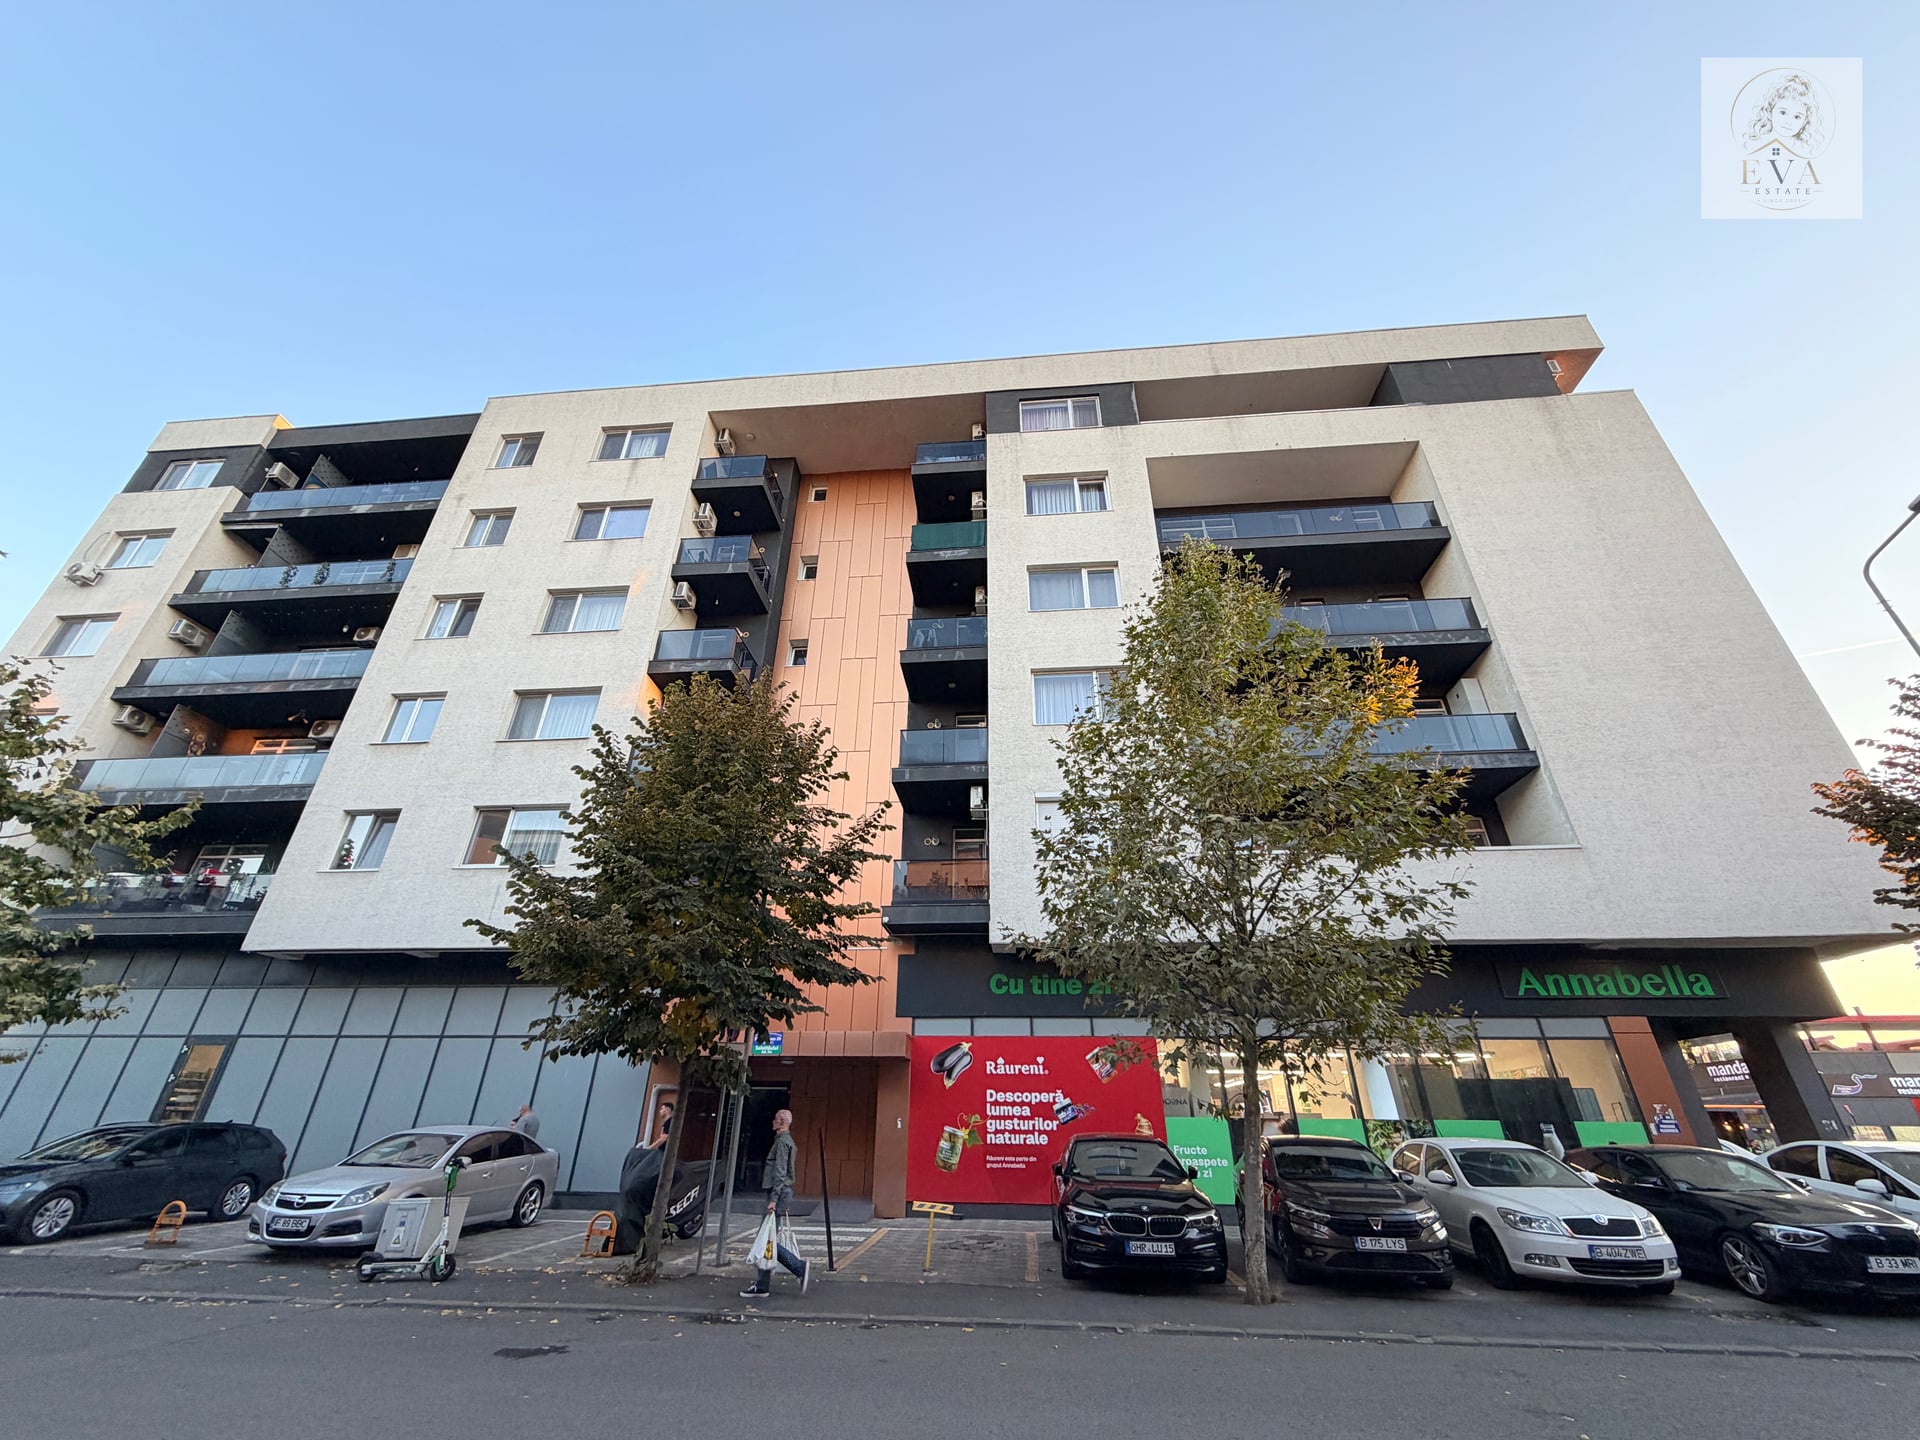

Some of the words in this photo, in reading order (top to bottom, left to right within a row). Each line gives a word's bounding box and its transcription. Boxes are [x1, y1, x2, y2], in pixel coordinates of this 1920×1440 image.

[990, 973, 1024, 995] Cu
[1030, 973, 1082, 995] tine
[1518, 964, 1715, 996] Annabella
[985, 1089, 1064, 1104] Descoperă
[985, 1103, 1031, 1116] lumea
[986, 1117, 1059, 1132] gusturilor
[986, 1131, 1049, 1145] naturale
[1173, 1145, 1208, 1155] Fructe
[1203, 1169, 1213, 1178] zi
[1360, 1237, 1367, 1248] B
[1385, 1239, 1405, 1249] LYS
[1875, 1257, 1885, 1269] B
[1885, 1257, 1899, 1269] 33
